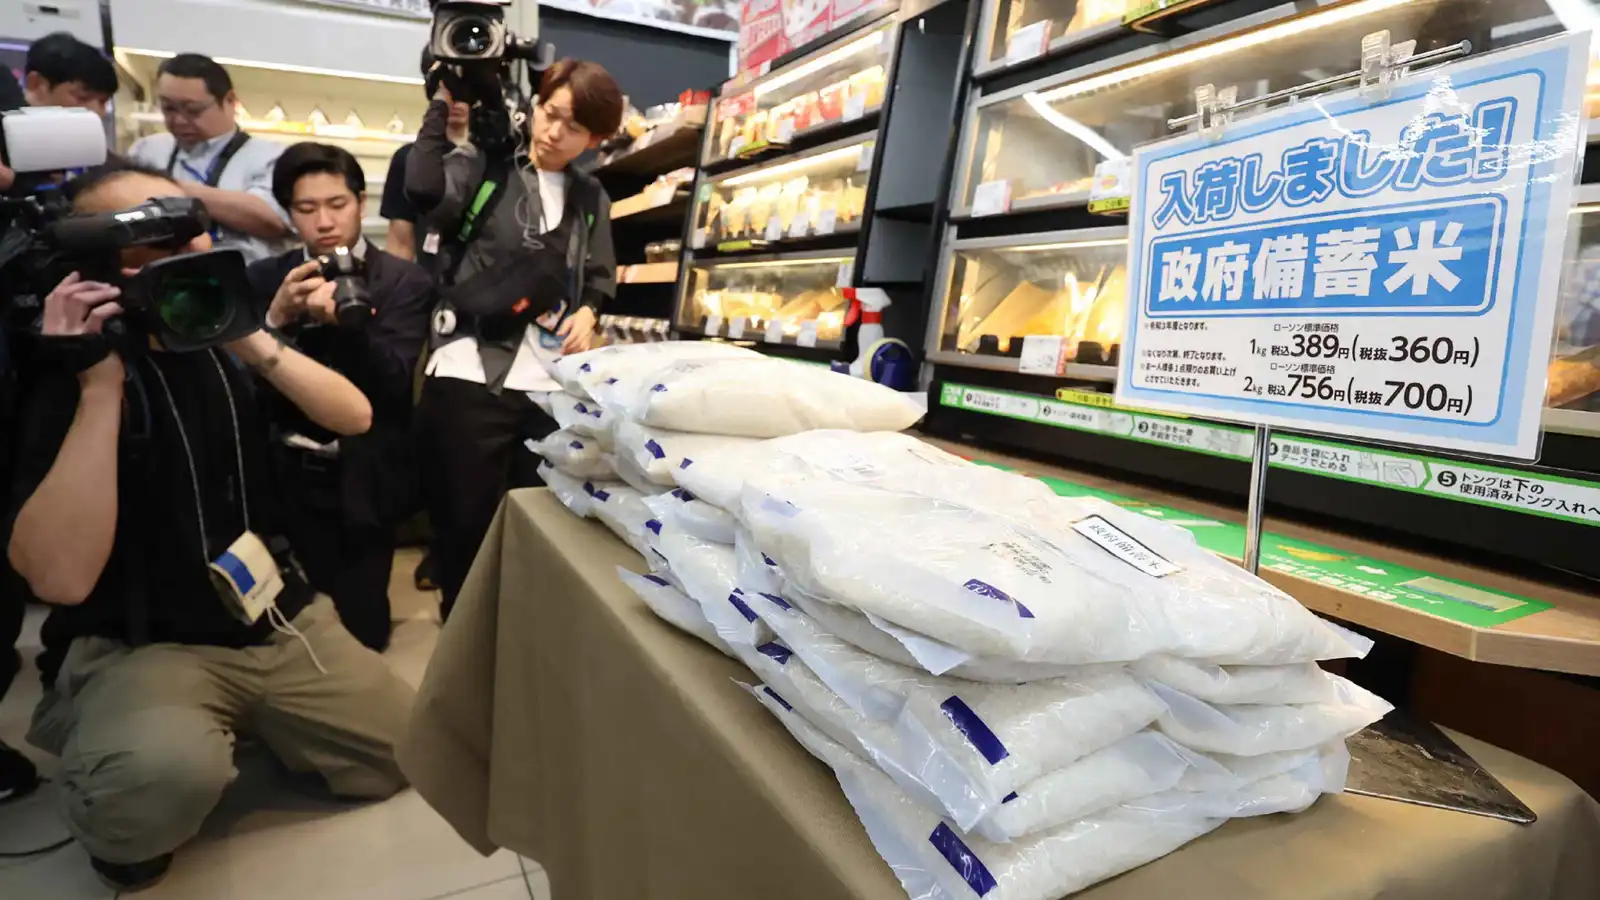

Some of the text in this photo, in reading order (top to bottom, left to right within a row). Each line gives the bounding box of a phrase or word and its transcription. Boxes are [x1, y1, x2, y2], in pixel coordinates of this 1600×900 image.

[1158, 220, 1465, 303] 政府備蓄米
[1273, 322, 1339, 334] ローソン標準価格
[1270, 362, 1336, 375] ローソン標準価格
[1280, 454, 1348, 472] テープでとめる
[1281, 444, 1350, 464] 商品を袋に入れ
[1462, 472, 1545, 495] トングは下の
